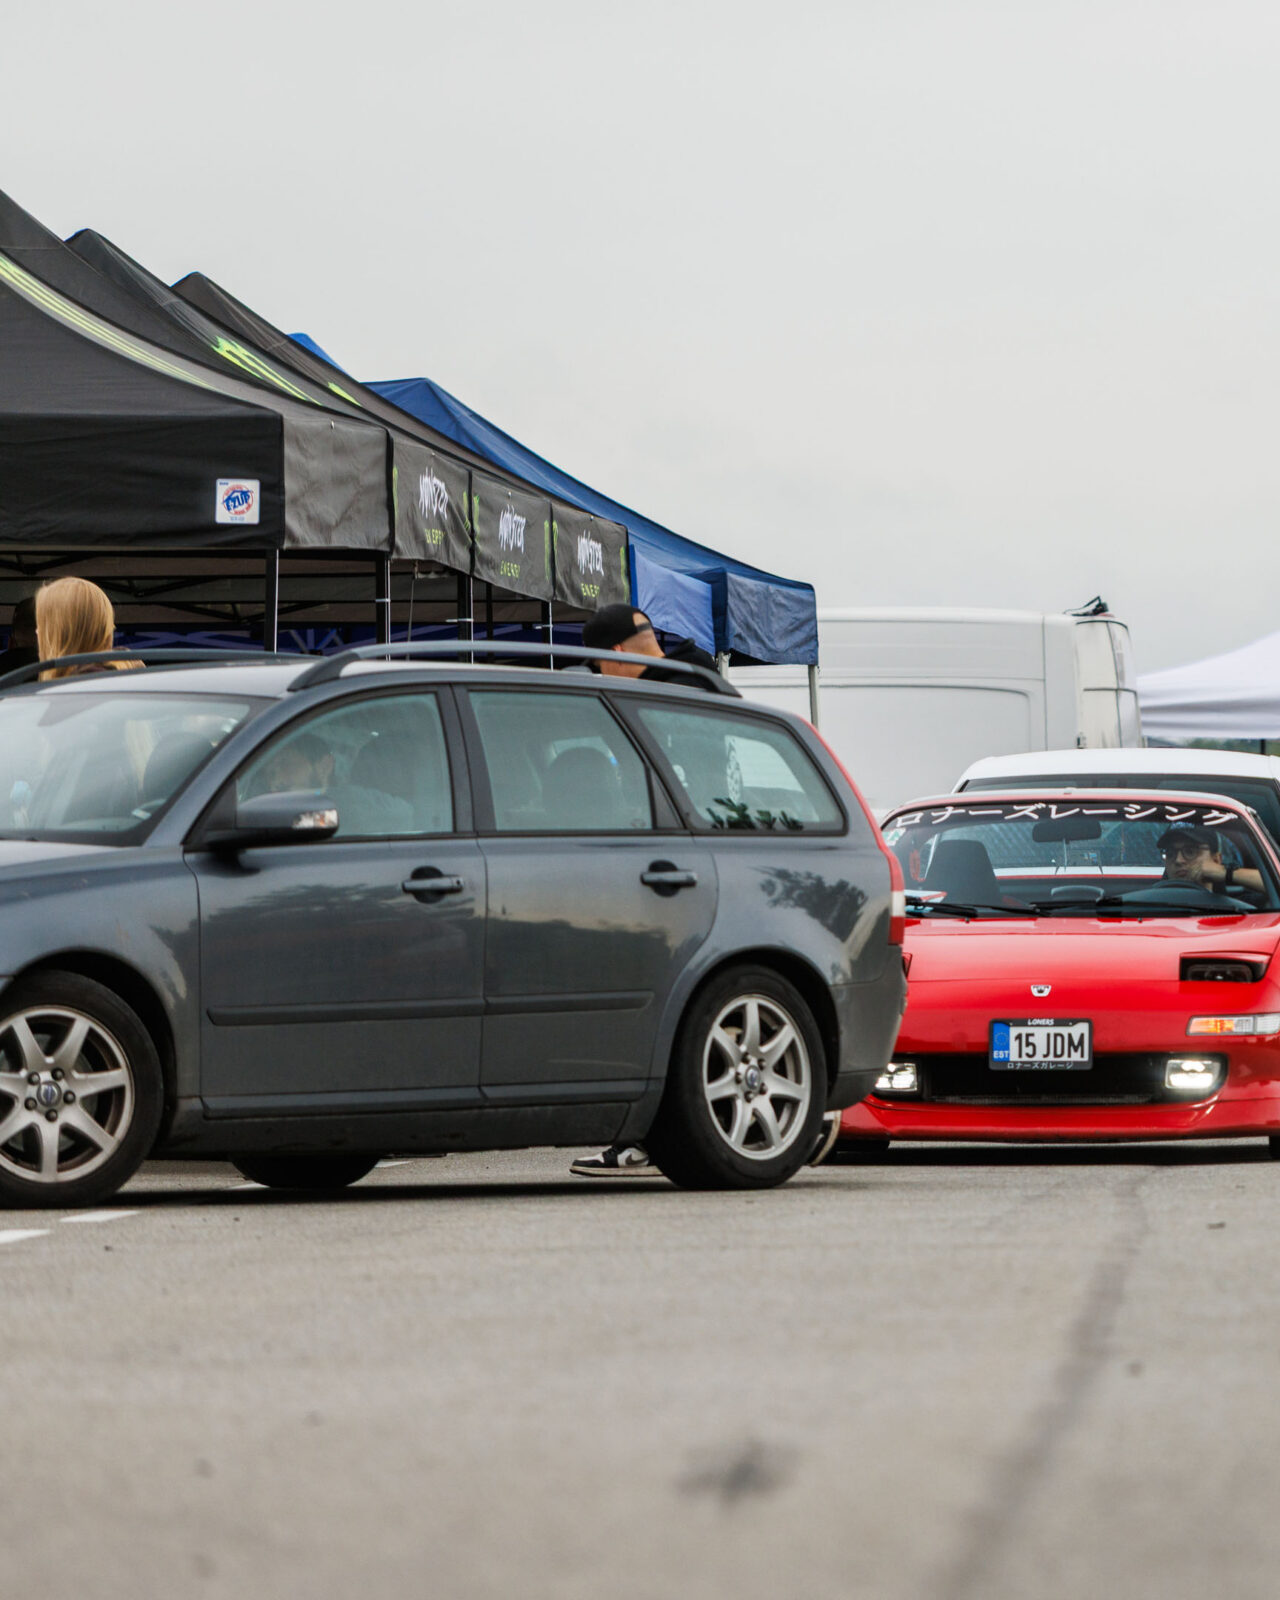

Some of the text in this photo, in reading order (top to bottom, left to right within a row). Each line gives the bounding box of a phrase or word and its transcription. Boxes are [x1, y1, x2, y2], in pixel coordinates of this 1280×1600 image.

[418, 467, 448, 519] MONSTER
[499, 504, 526, 554] MONSTER
[577, 530, 604, 576] MONSTER
[1027, 1018, 1055, 1026] LONERS
[993, 1050, 1009, 1059] EST
[1014, 1032, 1085, 1059] 15 JDM
